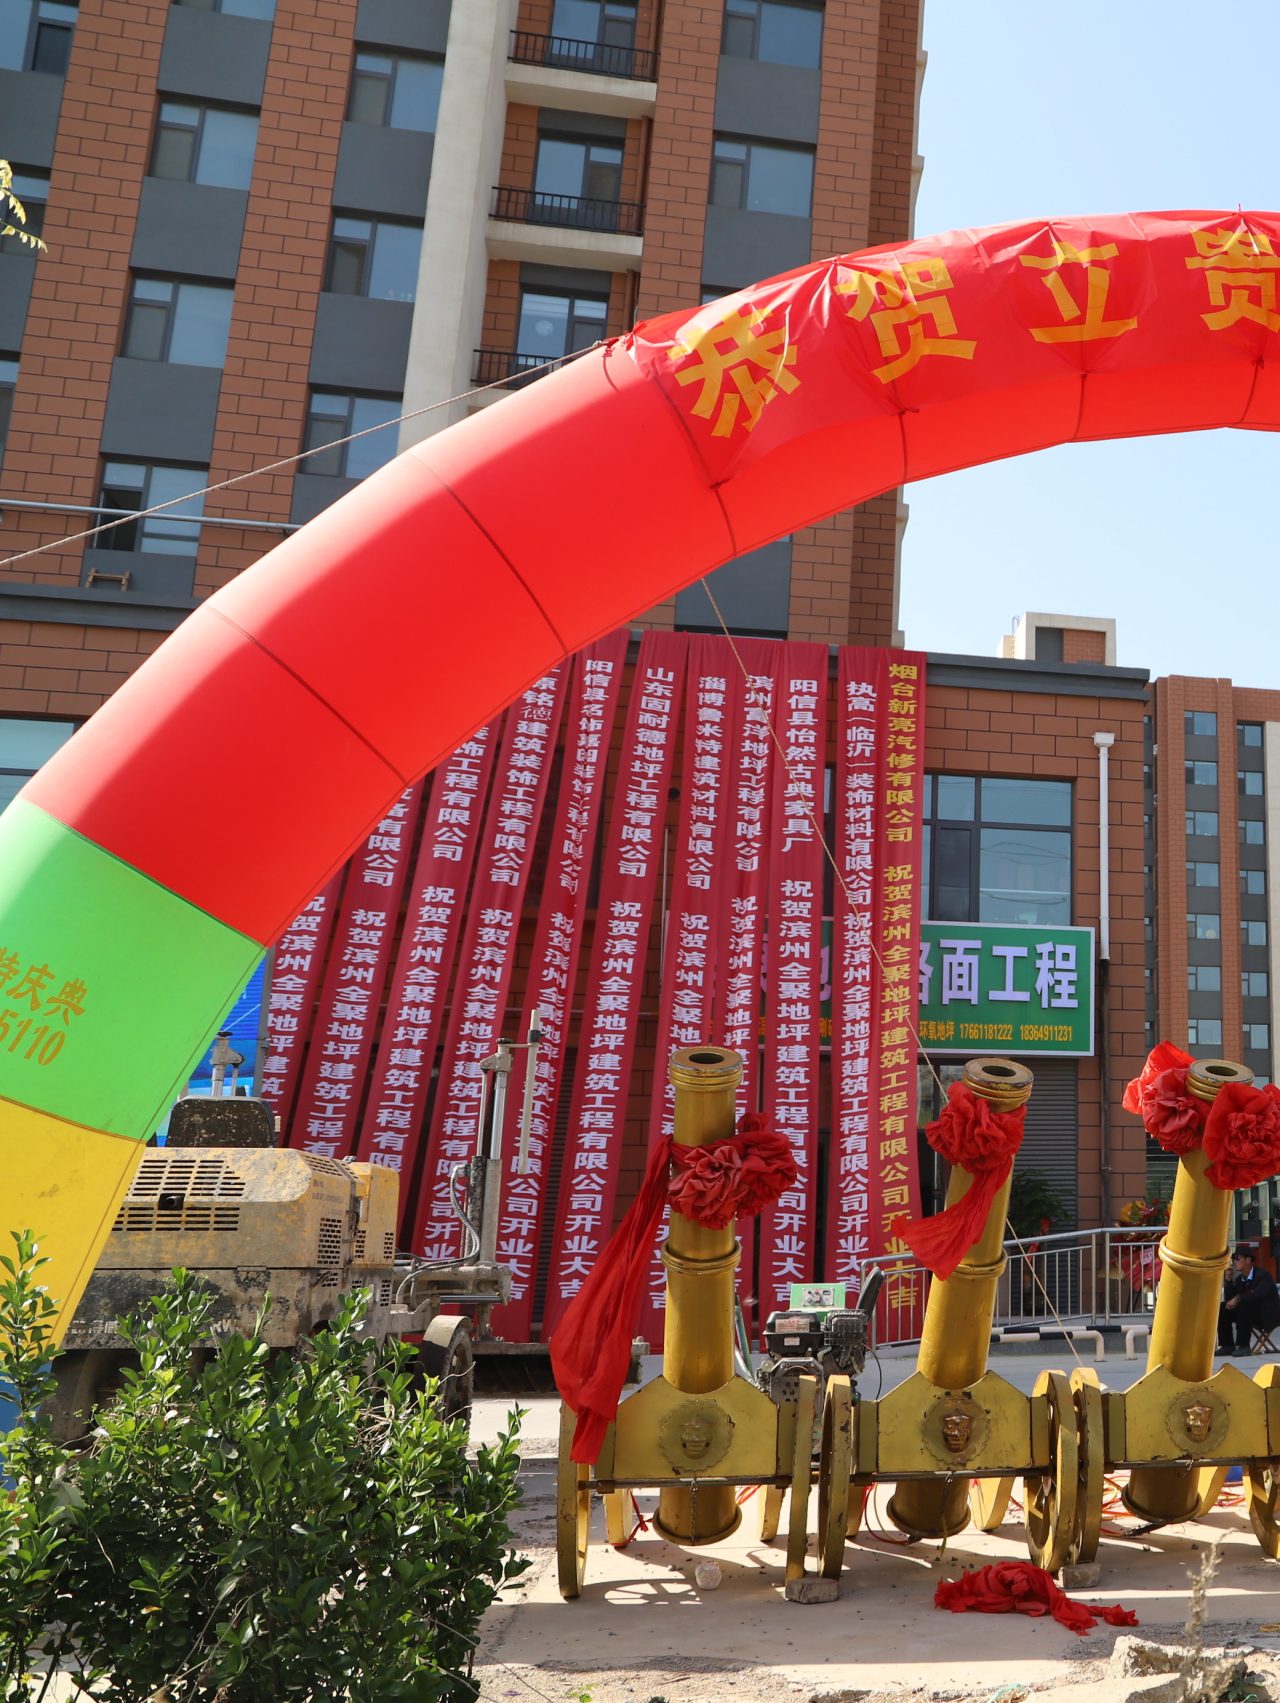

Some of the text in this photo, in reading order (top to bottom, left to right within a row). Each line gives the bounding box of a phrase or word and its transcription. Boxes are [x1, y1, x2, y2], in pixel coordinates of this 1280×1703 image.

[619, 668, 674, 877] 山东固耐德地坪工程有限公司
[687, 677, 726, 889] 淄博鲁米特建筑材料有限公司
[782, 680, 818, 852] 阳信县怡然古典家具厂
[886, 664, 917, 842] 烟台新亮汽修有限公司
